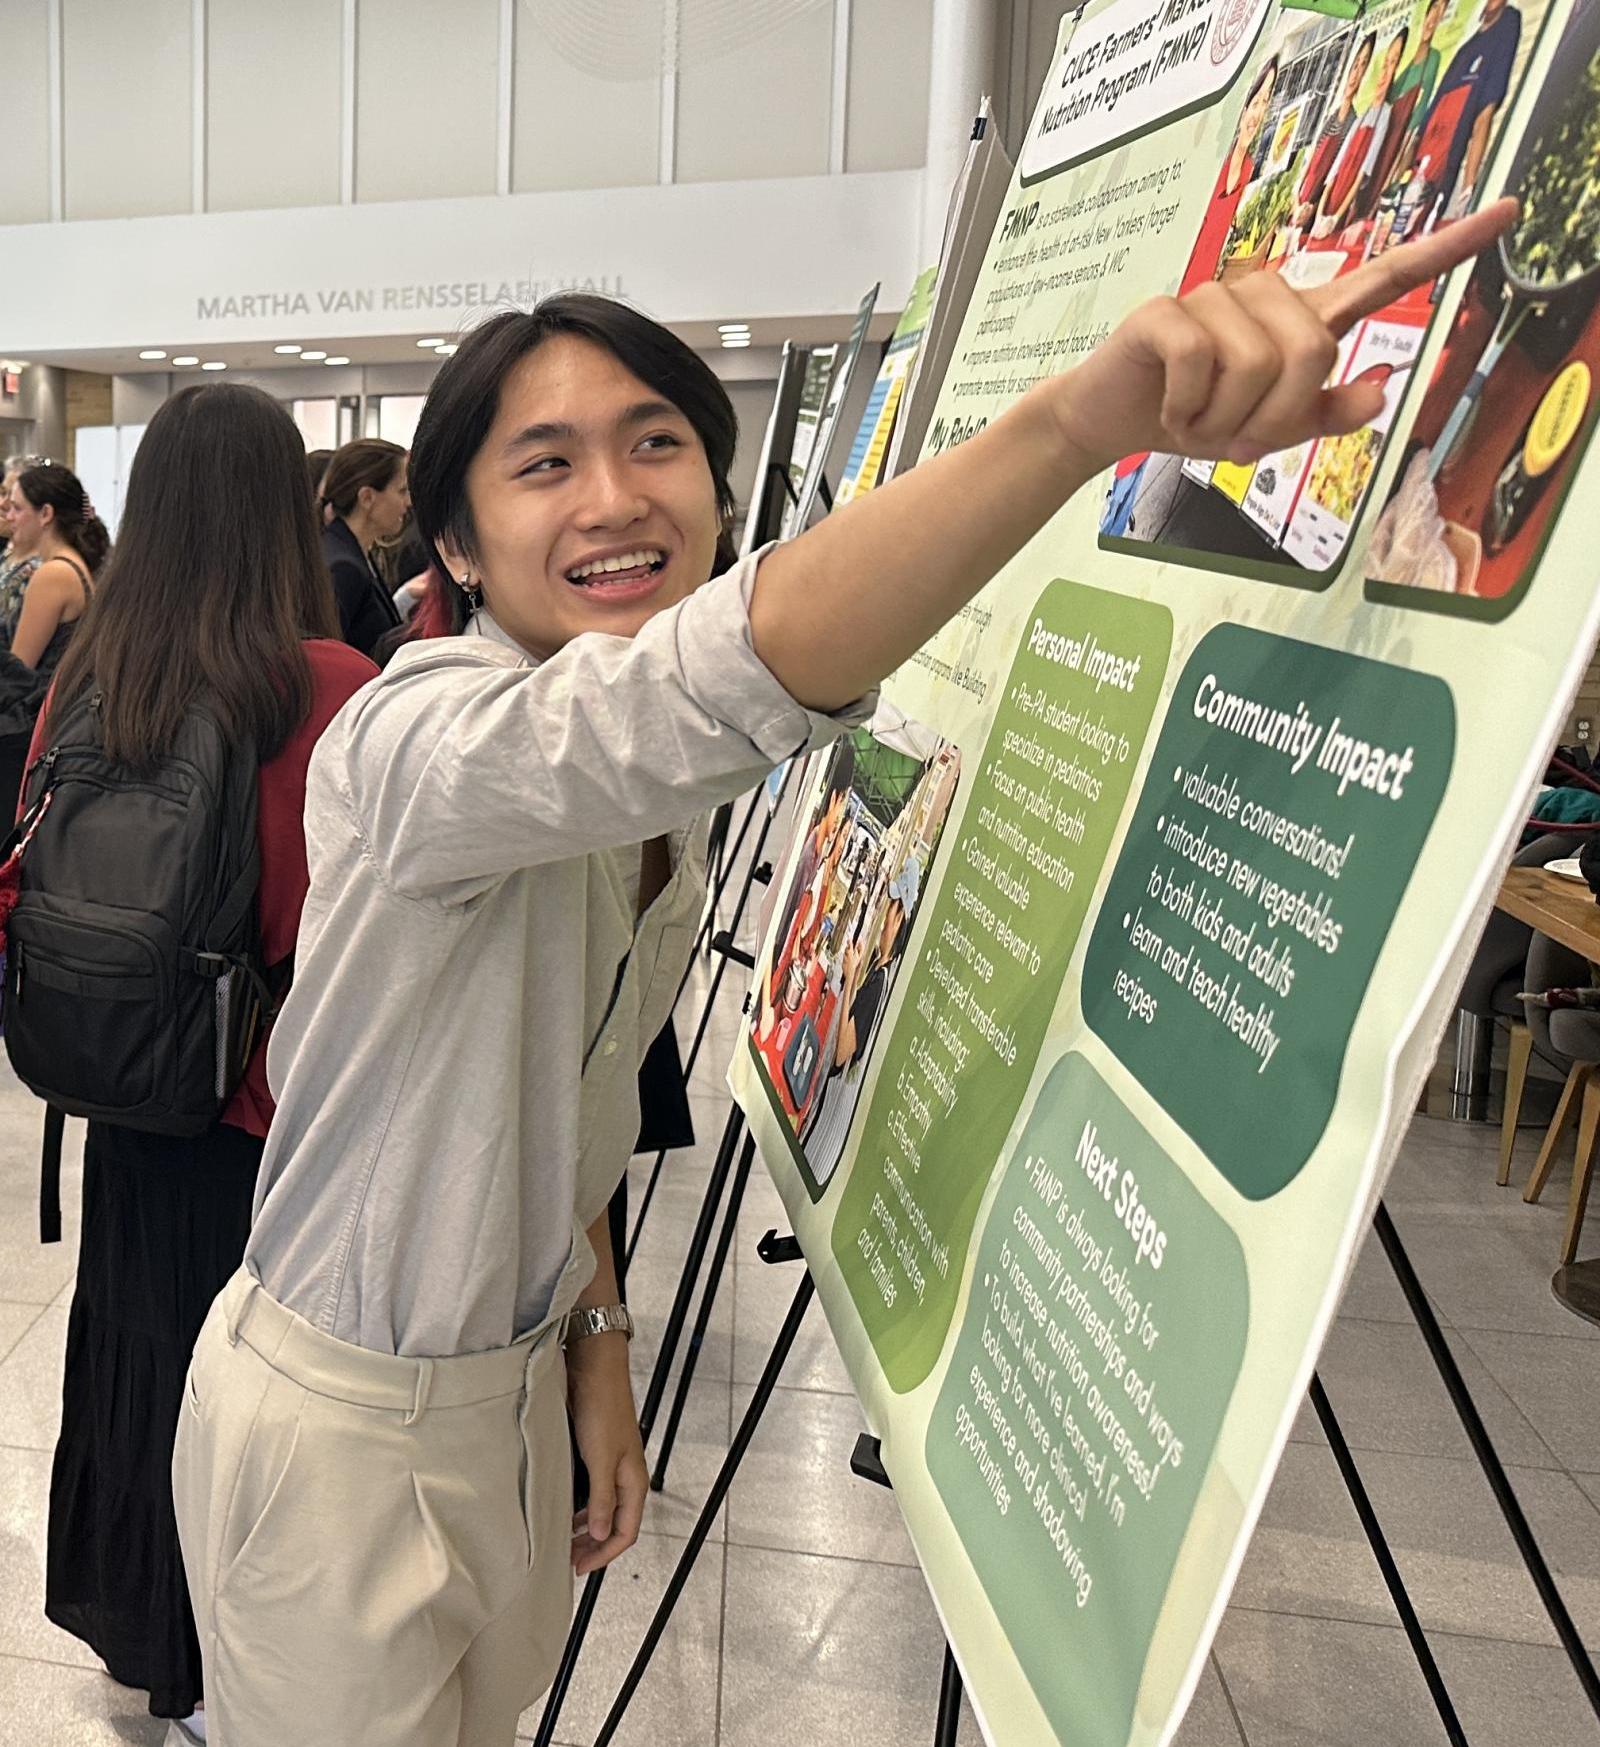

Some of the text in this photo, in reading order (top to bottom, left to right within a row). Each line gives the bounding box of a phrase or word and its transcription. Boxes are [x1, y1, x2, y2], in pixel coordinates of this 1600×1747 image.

[1037, 12, 1213, 138] Nutrition Program (FMNP)
[998, 200, 1040, 243] FMNP
[1084, 177, 1139, 213] collaboration
[1138, 167, 1170, 195] aiming
[1094, 221, 1114, 246] New
[1113, 208, 1147, 240] Yorkers
[1141, 197, 1181, 240] (target
[198, 293, 311, 320] MARTHA
[316, 288, 374, 316] VAN
[1108, 246, 1131, 276] WIC
[1053, 328, 1076, 357] and
[1069, 322, 1094, 354] food
[928, 416, 949, 458] My
[1027, 618, 1142, 694] Personal Impact
[1002, 728, 1103, 802] specialize in pediatrics
[1015, 682, 1130, 765] Pre-PA student looking to
[1193, 673, 1415, 801] Community Impact
[978, 802, 1076, 894] and nutrition education
[990, 759, 1087, 846] Focus on public health
[1182, 763, 1356, 879] valuable conversations!
[967, 836, 1031, 911] Gained valuable
[1163, 815, 1343, 954] introduce new vegetables
[938, 918, 994, 985] pediatric care
[953, 882, 1041, 976] experience relevant to
[1146, 863, 1296, 998] to both kids and adults
[928, 947, 1018, 1067] Developed transferable
[933, 1007, 971, 1074] including:
[1113, 968, 1158, 1024] recipes
[1128, 906, 1281, 1074] learn and teach healthy
[883, 1155, 950, 1280] communication with
[1074, 1119, 1168, 1270] Next Steps
[857, 1227, 898, 1309] and families
[870, 1191, 926, 1307] parents, children,
[1028, 1156, 1160, 1352] FMNP is always looking for
[999, 1238, 1161, 1501] to increase nutrition awareness!
[1013, 1205, 1185, 1468] community partnerships and ways
[981, 1312, 1089, 1523] looking for more clinical
[990, 1274, 1126, 1528] To build what I've learned, I'm
[954, 1402, 1012, 1516] opportunities
[969, 1364, 1093, 1608] experience and shadowing
